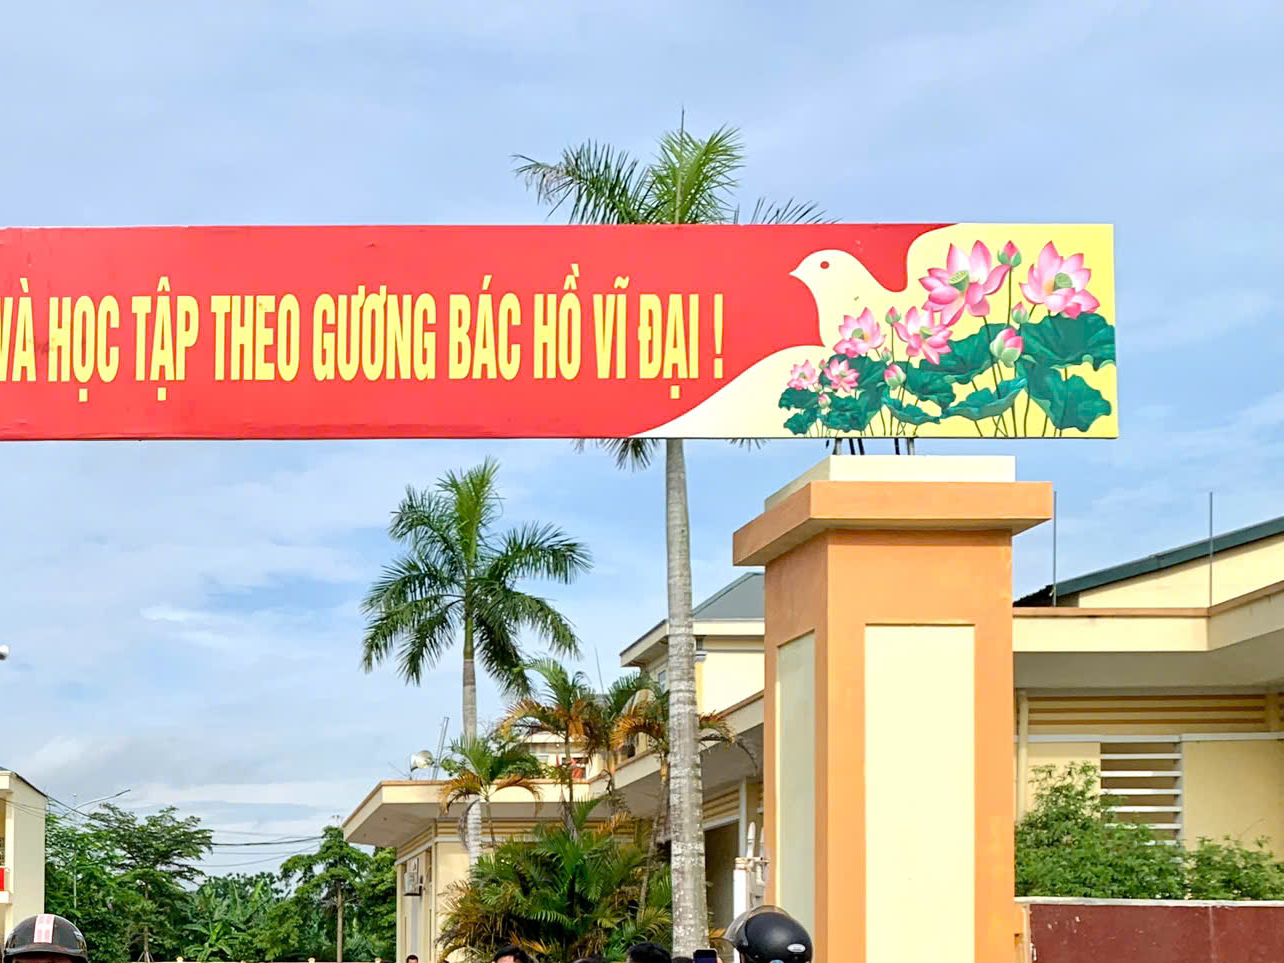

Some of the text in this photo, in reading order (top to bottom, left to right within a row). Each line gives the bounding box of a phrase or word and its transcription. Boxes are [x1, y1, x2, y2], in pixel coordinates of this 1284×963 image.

[47, 296, 120, 402] HỌC
[132, 276, 199, 401] TẬP
[211, 294, 300, 381] THEO
[313, 285, 437, 381] GƯƠNG
[449, 275, 521, 380] BÁC
[533, 263, 581, 380] HỒ
[592, 277, 630, 379] VĨ
[637, 294, 699, 399] ĐẠI
